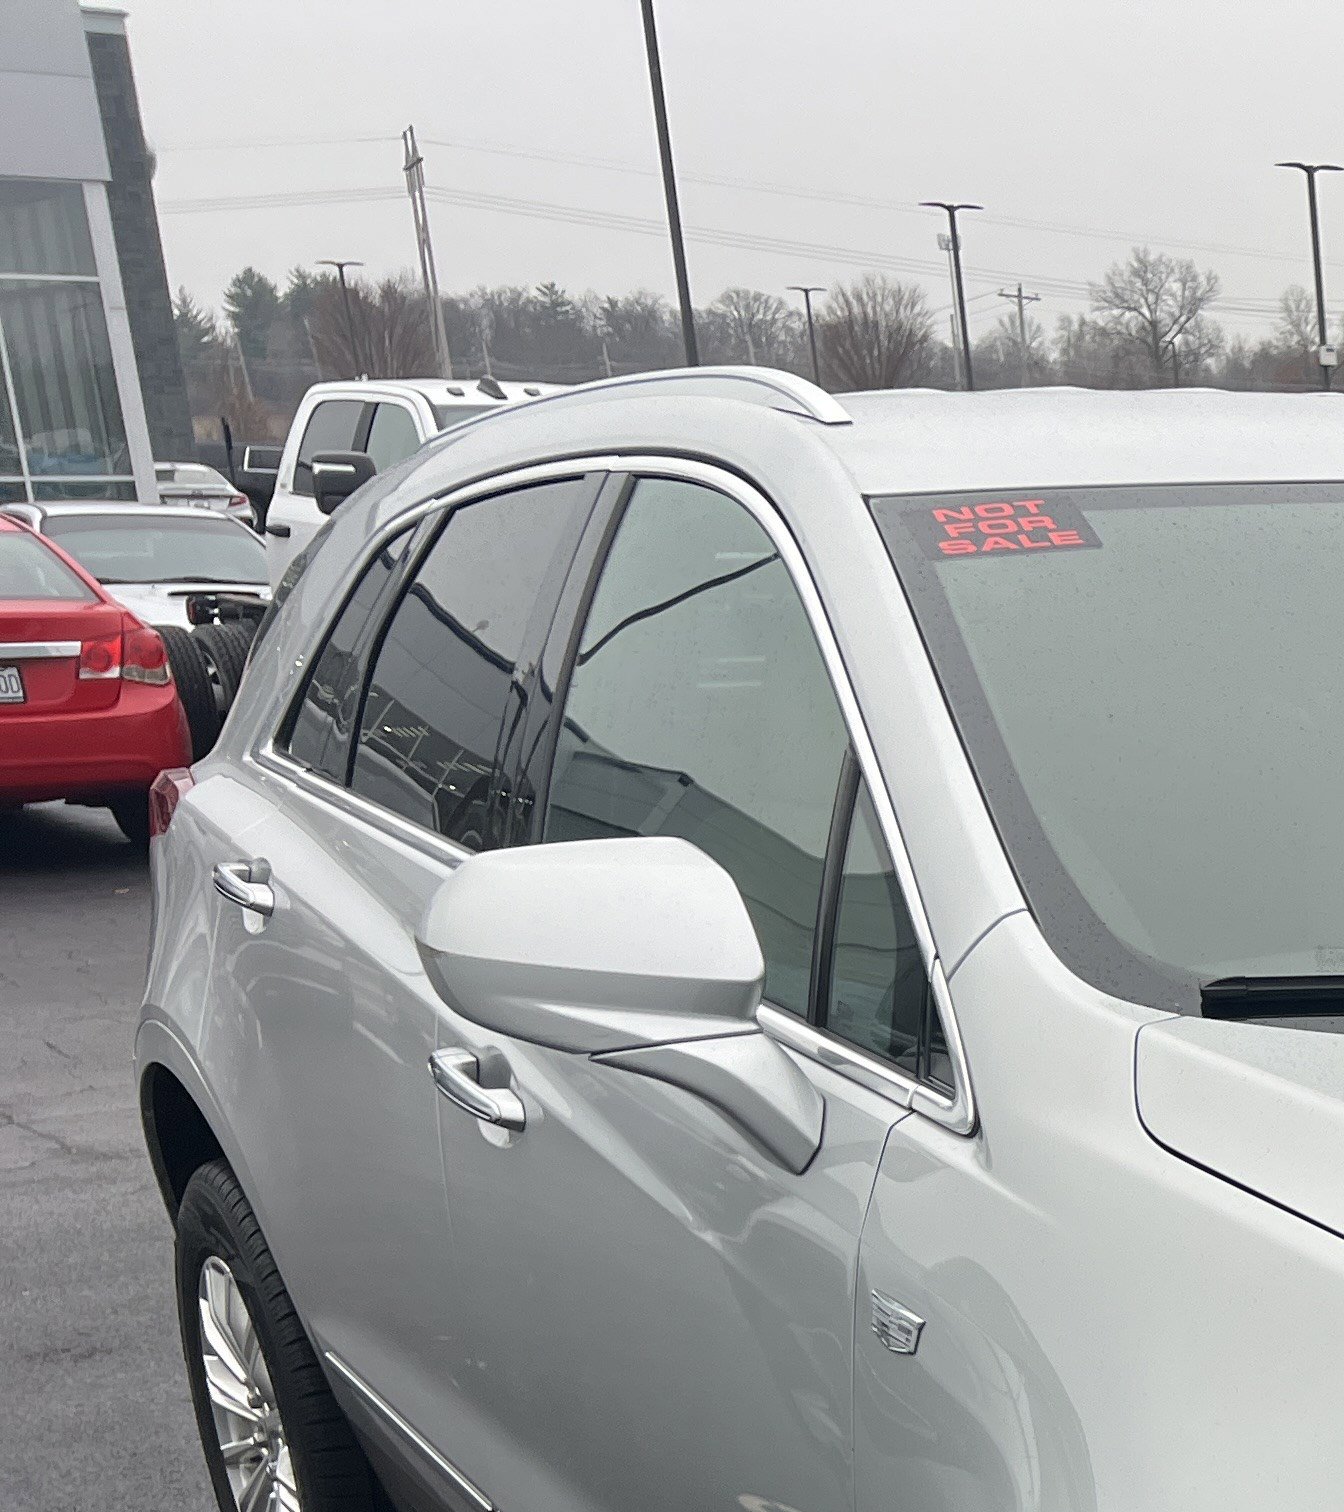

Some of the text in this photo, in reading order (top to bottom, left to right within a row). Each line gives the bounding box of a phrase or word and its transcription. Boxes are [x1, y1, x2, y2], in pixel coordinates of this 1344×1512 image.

[932, 499, 1045, 523] NOT
[944, 516, 1057, 538] FOR
[938, 530, 1084, 555] SALE
